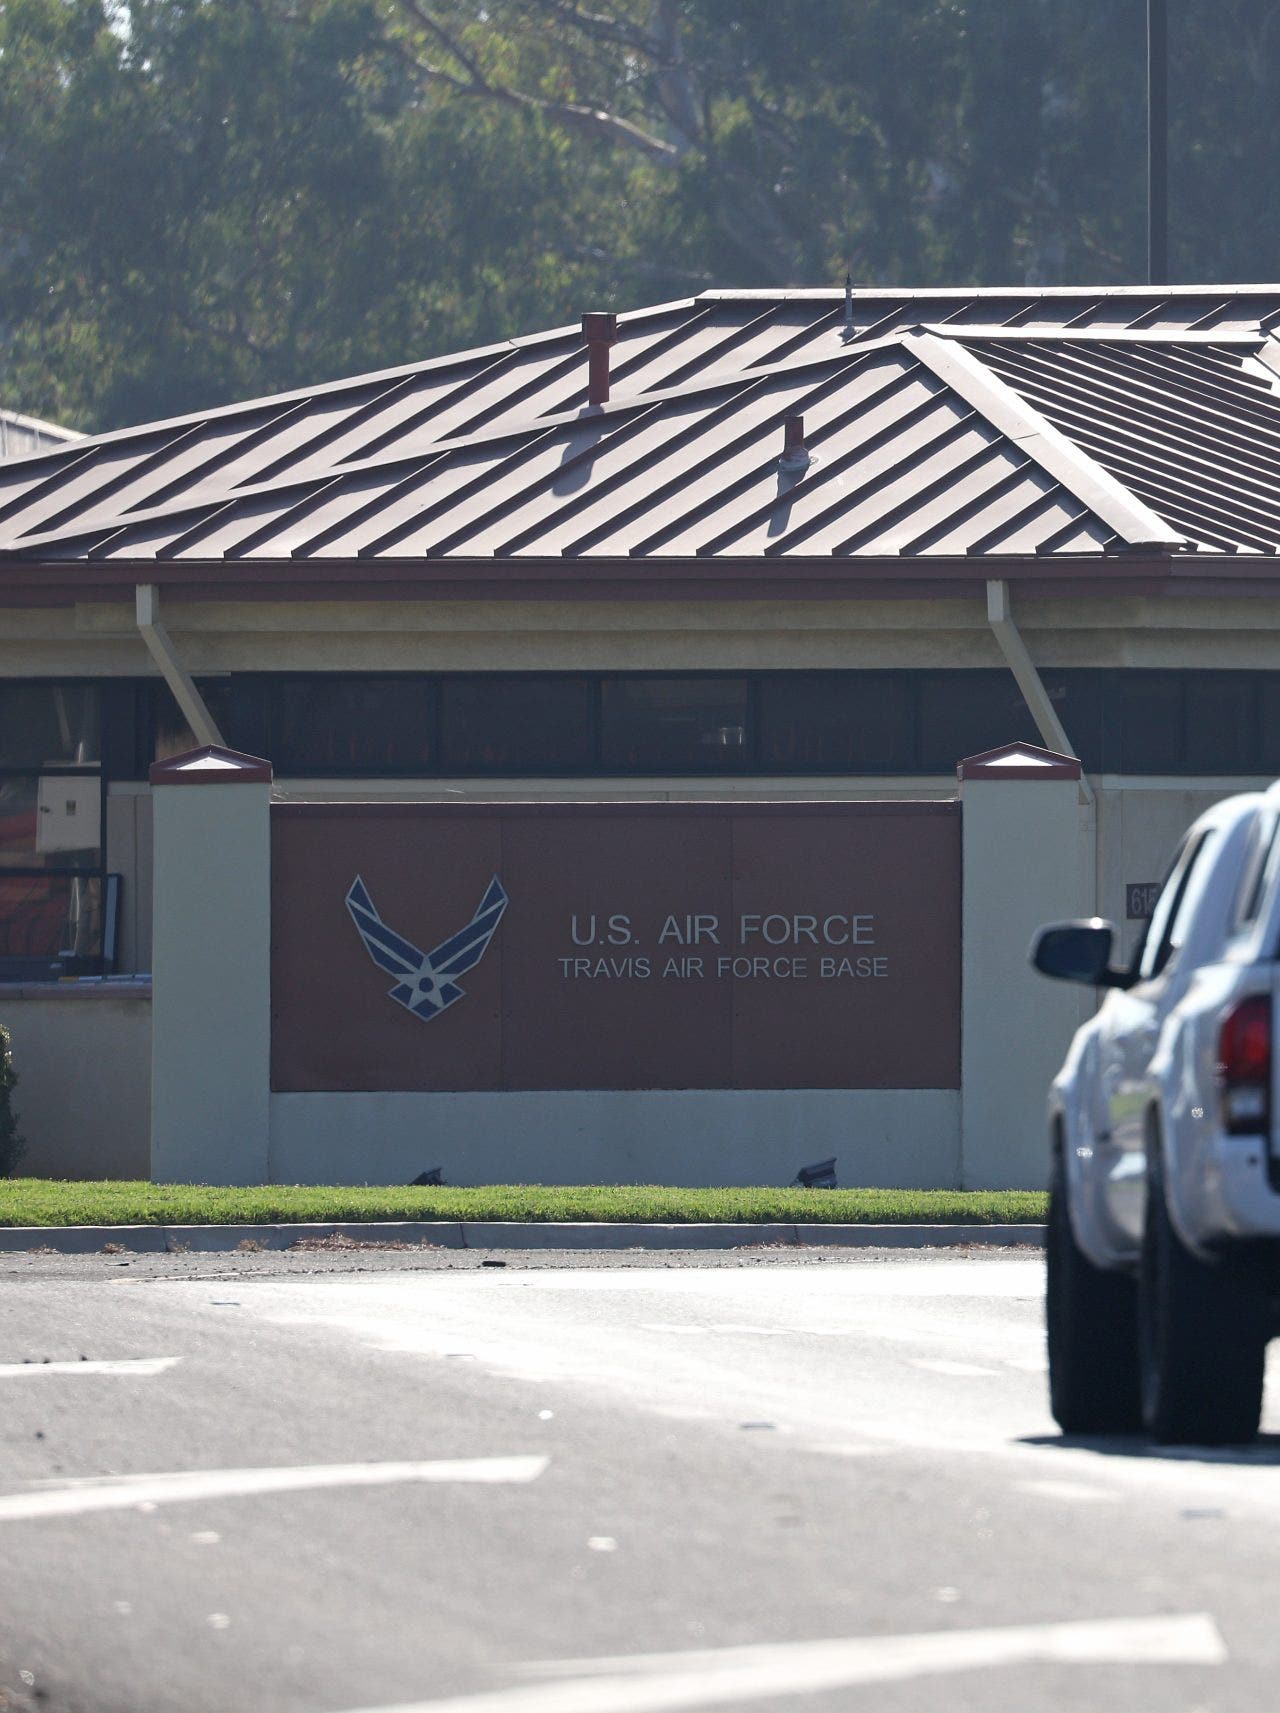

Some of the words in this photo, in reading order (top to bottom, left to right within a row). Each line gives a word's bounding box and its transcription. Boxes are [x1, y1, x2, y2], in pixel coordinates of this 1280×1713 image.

[570, 913, 640, 946] U.S.
[657, 913, 721, 945] AIR
[739, 913, 876, 946] FORCE
[557, 957, 651, 979] TRAVIS
[661, 957, 705, 979] AIR
[716, 957, 808, 979] FORCE
[819, 956, 889, 978] BASE
